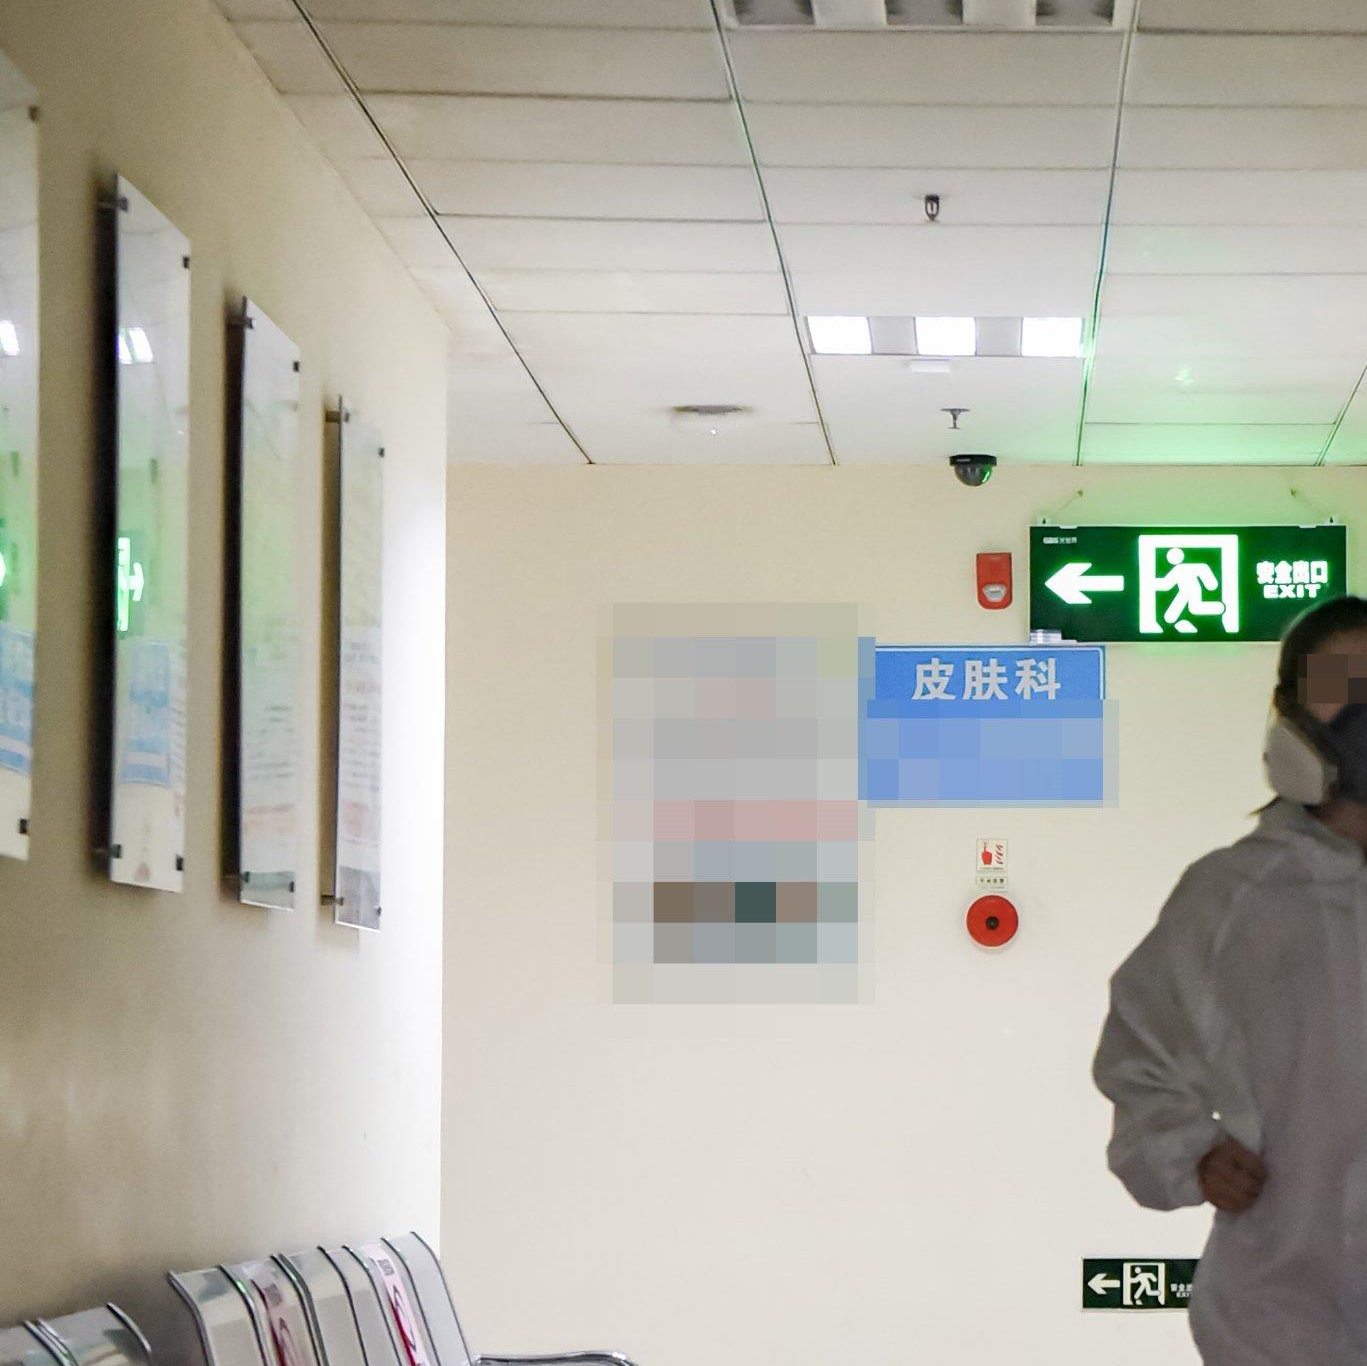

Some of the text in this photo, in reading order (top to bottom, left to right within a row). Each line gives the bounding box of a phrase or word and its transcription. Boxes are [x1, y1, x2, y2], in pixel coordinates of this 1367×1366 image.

[1256, 561, 1328, 584] 安全出口
[1263, 584, 1321, 598] EXIT
[911, 657, 1062, 700] 皮肤科
